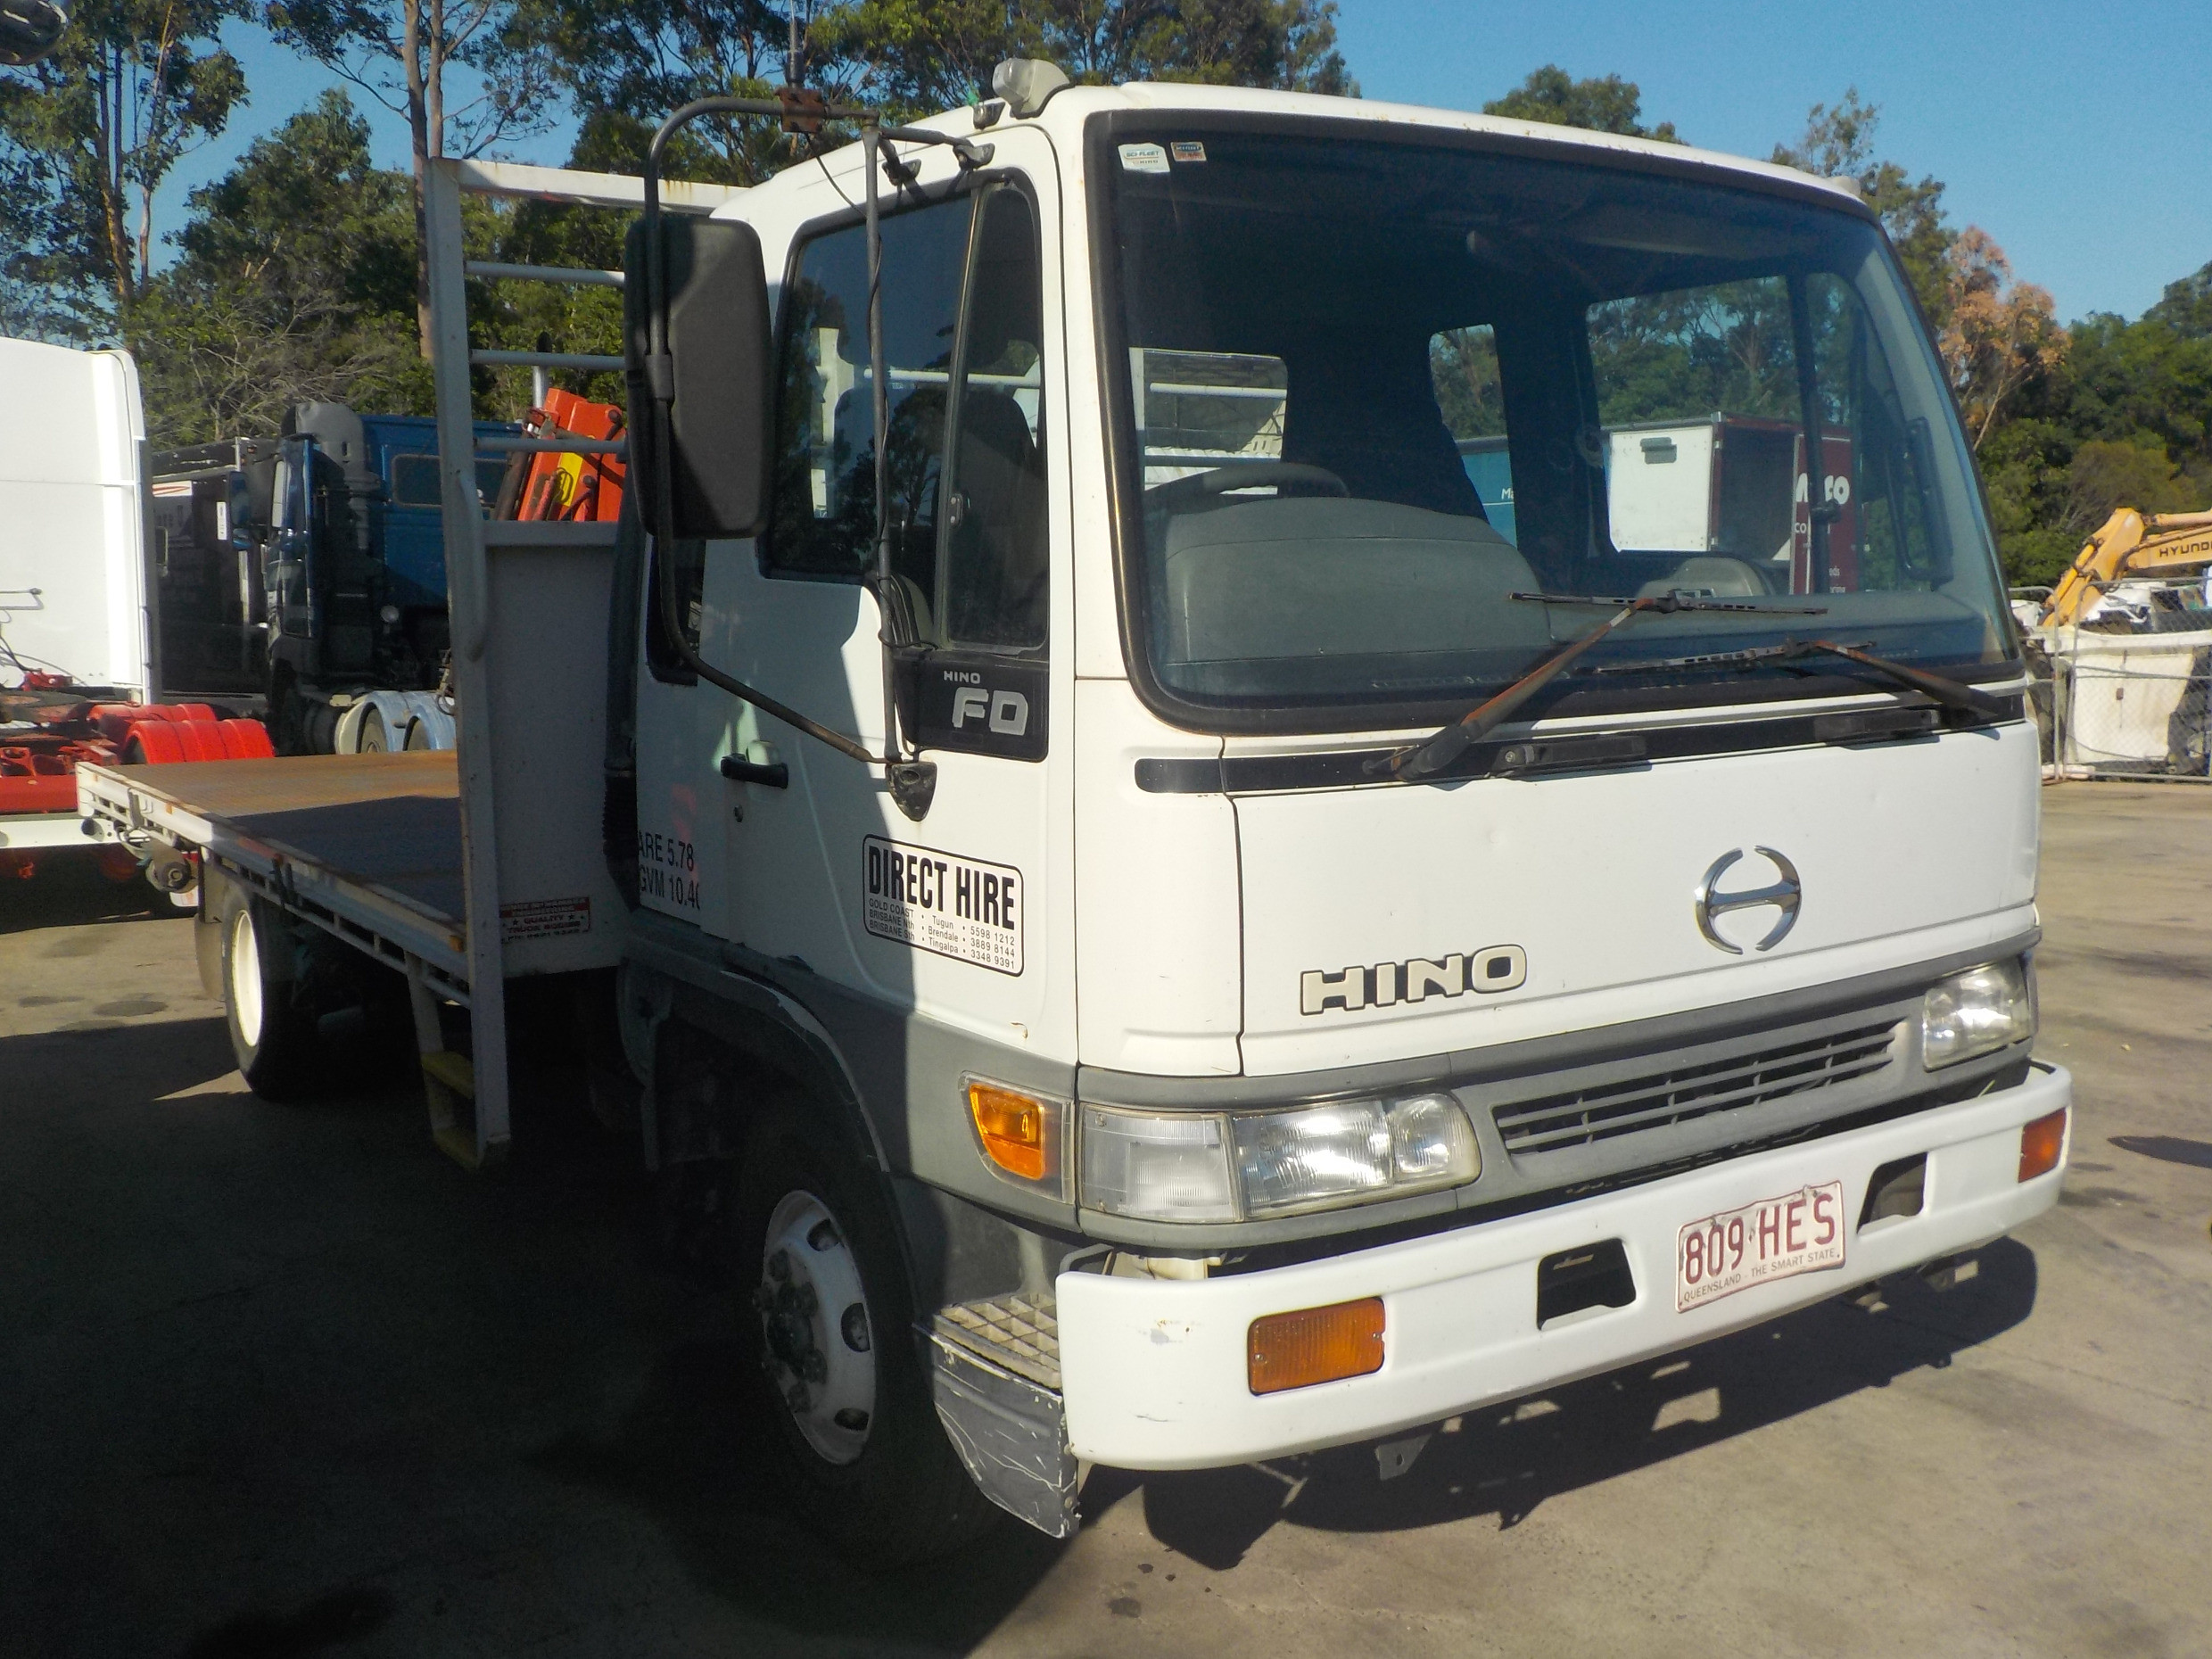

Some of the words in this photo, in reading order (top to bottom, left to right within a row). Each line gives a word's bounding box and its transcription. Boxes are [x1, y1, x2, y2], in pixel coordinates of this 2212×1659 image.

[2159, 541, 2212, 557] HYUND
[944, 671, 981, 684] HINO
[952, 687, 1029, 736] FD
[668, 838, 694, 871] 5.78
[640, 864, 664, 898] GVM
[869, 846, 947, 912] DIRECT
[956, 865, 1015, 930] HIRE
[869, 898, 887, 910] GOLD
[890, 904, 914, 918] COAST
[869, 909, 902, 926] BRISBANE
[903, 919, 914, 930] Nth
[869, 920, 902, 937] BRISBANE
[904, 929, 915, 941] Sth
[928, 925, 959, 943] Brendale
[970, 937, 991, 952] 3889
[994, 944, 1015, 958] 8144
[932, 915, 953, 929] Tugun
[970, 926, 991, 939] 5598
[995, 932, 1015, 946] 1212
[929, 937, 959, 953] Tingalpa
[970, 949, 991, 963] 3348
[994, 955, 1015, 970] 9391
[1300, 944, 1528, 1016] HINO
[1685, 1215, 1745, 1284] 809
[1758, 1193, 1836, 1259] HES
[1683, 1273, 1741, 1302] QUEENSLAND
[1751, 1266, 1767, 1278] THE
[1770, 1255, 1804, 1272] SMART
[1807, 1248, 1835, 1263] STATE
